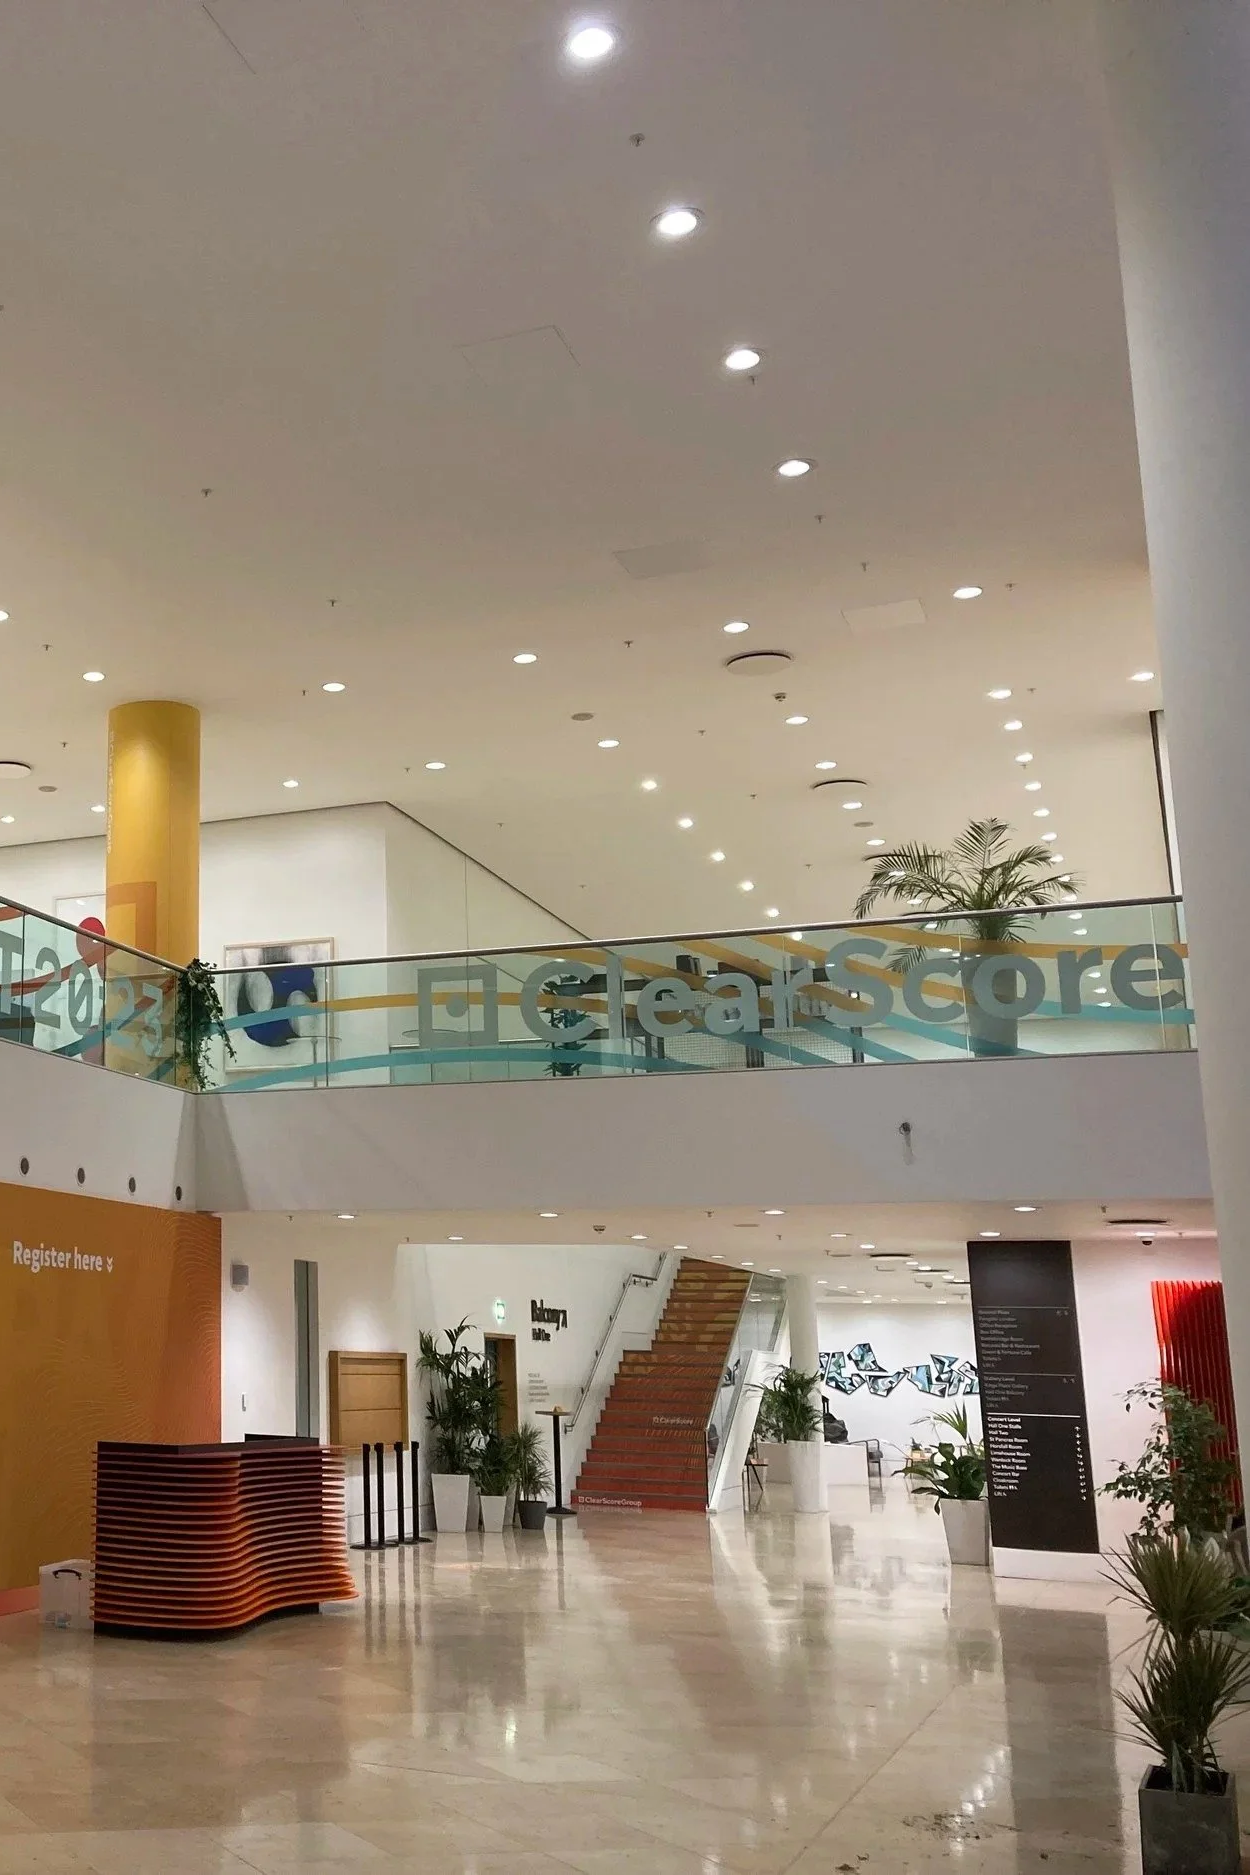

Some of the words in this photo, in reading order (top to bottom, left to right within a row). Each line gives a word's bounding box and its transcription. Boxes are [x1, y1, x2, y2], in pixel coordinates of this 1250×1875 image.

[520, 938, 1186, 1043] ClearScore
[14, 1240, 72, 1274] Register
[74, 1246, 103, 1272] here
[585, 1496, 642, 1508] ClearScoreGroup
